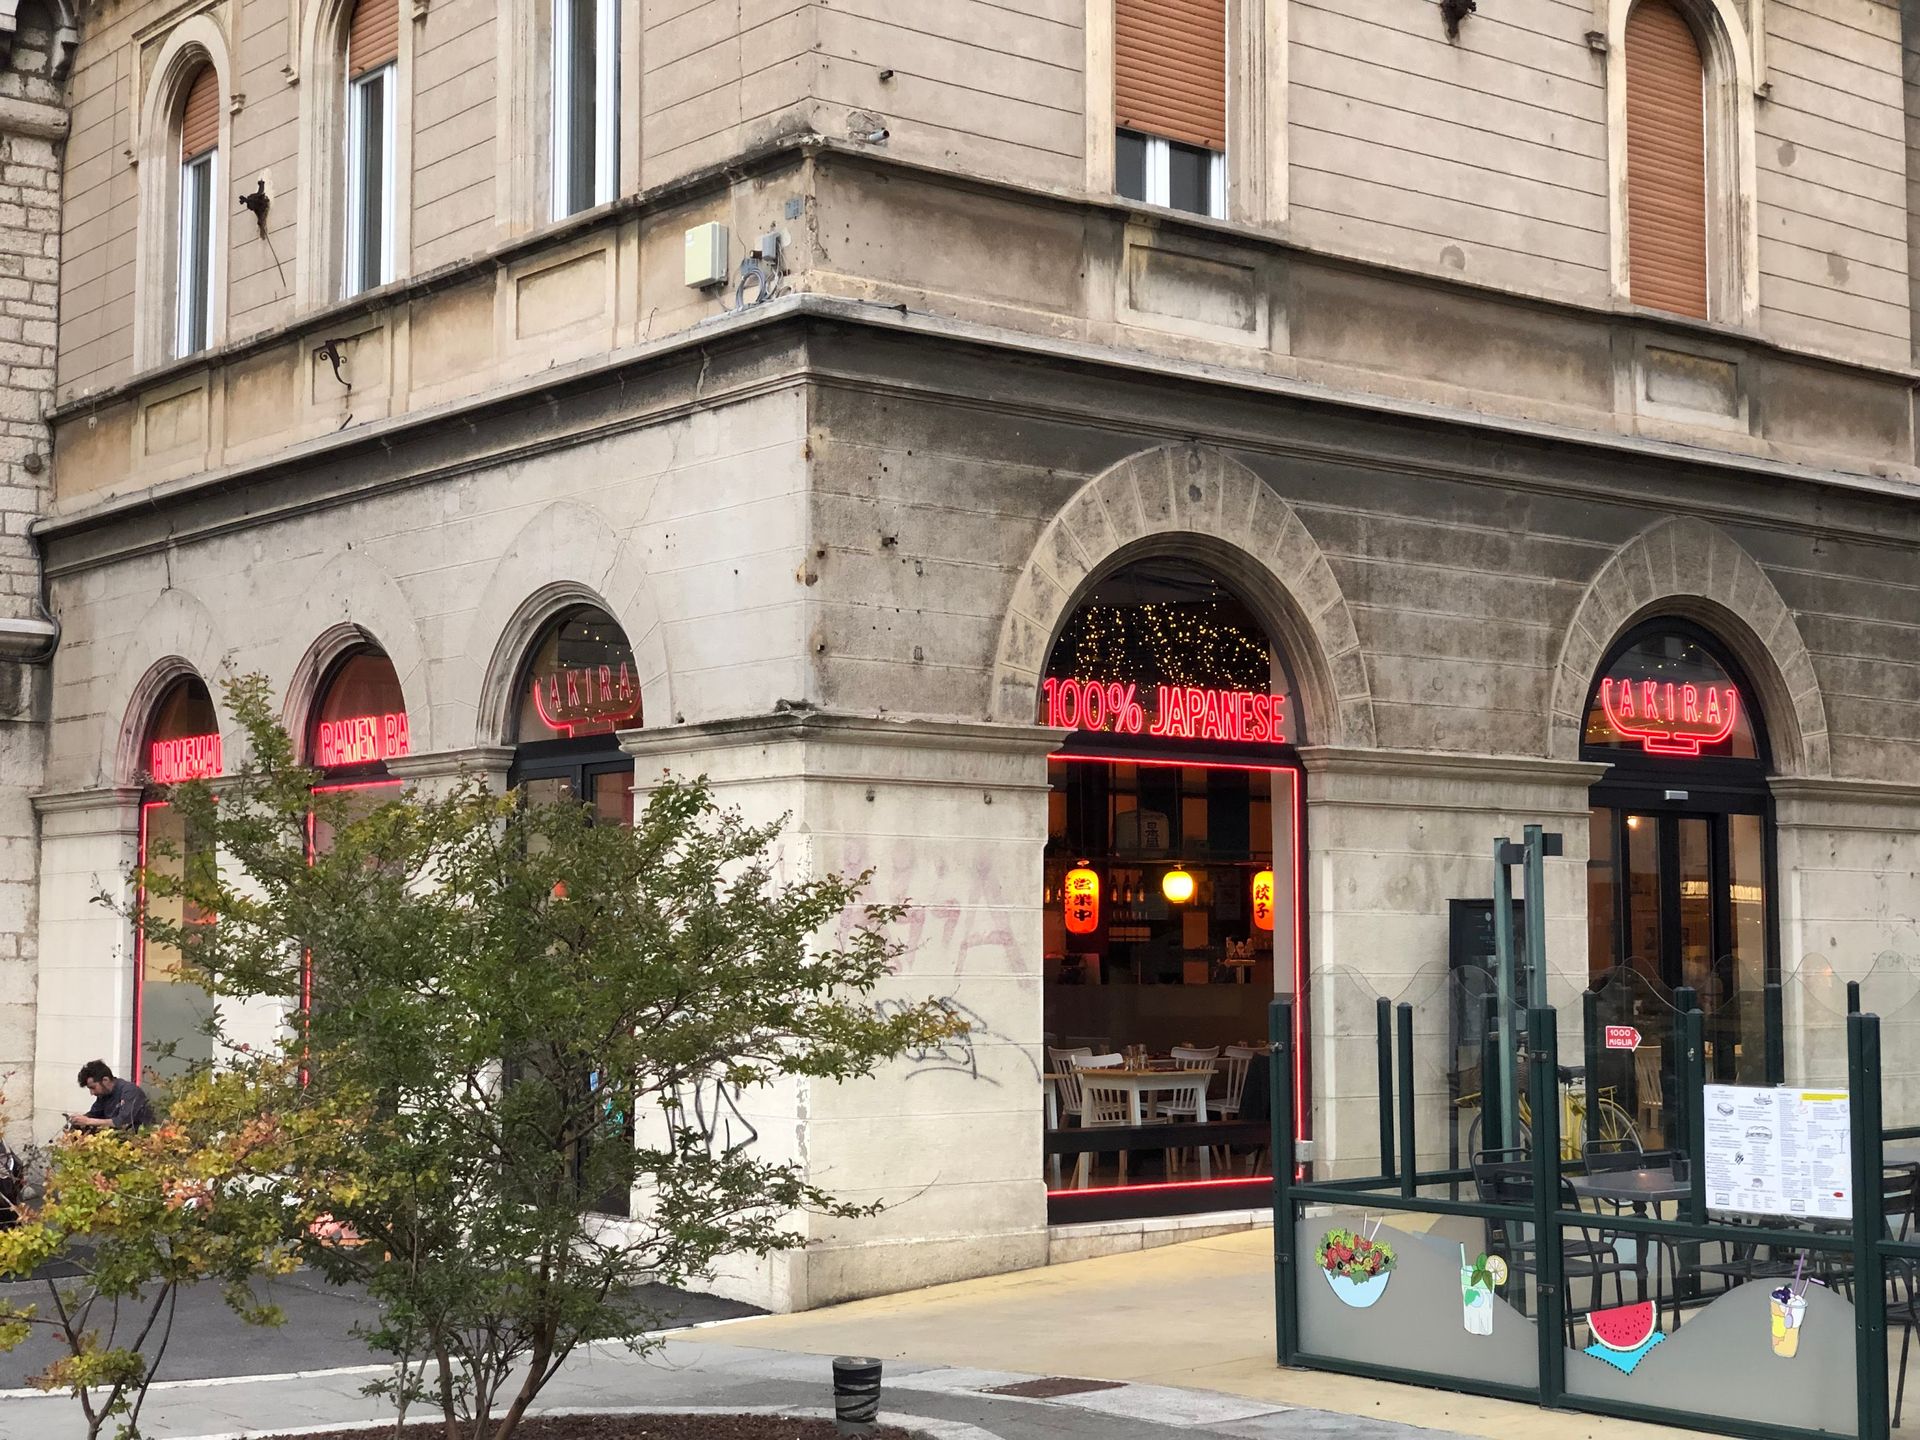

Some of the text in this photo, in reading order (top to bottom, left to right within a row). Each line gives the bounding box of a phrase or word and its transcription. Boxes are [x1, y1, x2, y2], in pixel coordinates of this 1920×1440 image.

[549, 661, 632, 710] AKIRA
[1620, 678, 1721, 725] AKIRA
[1043, 678, 1286, 743] 100% JAPANESE
[320, 717, 379, 767] RAMEN
[1608, 1038, 1633, 1046] MIGLIA
[1610, 1029, 1631, 1037] 1000
